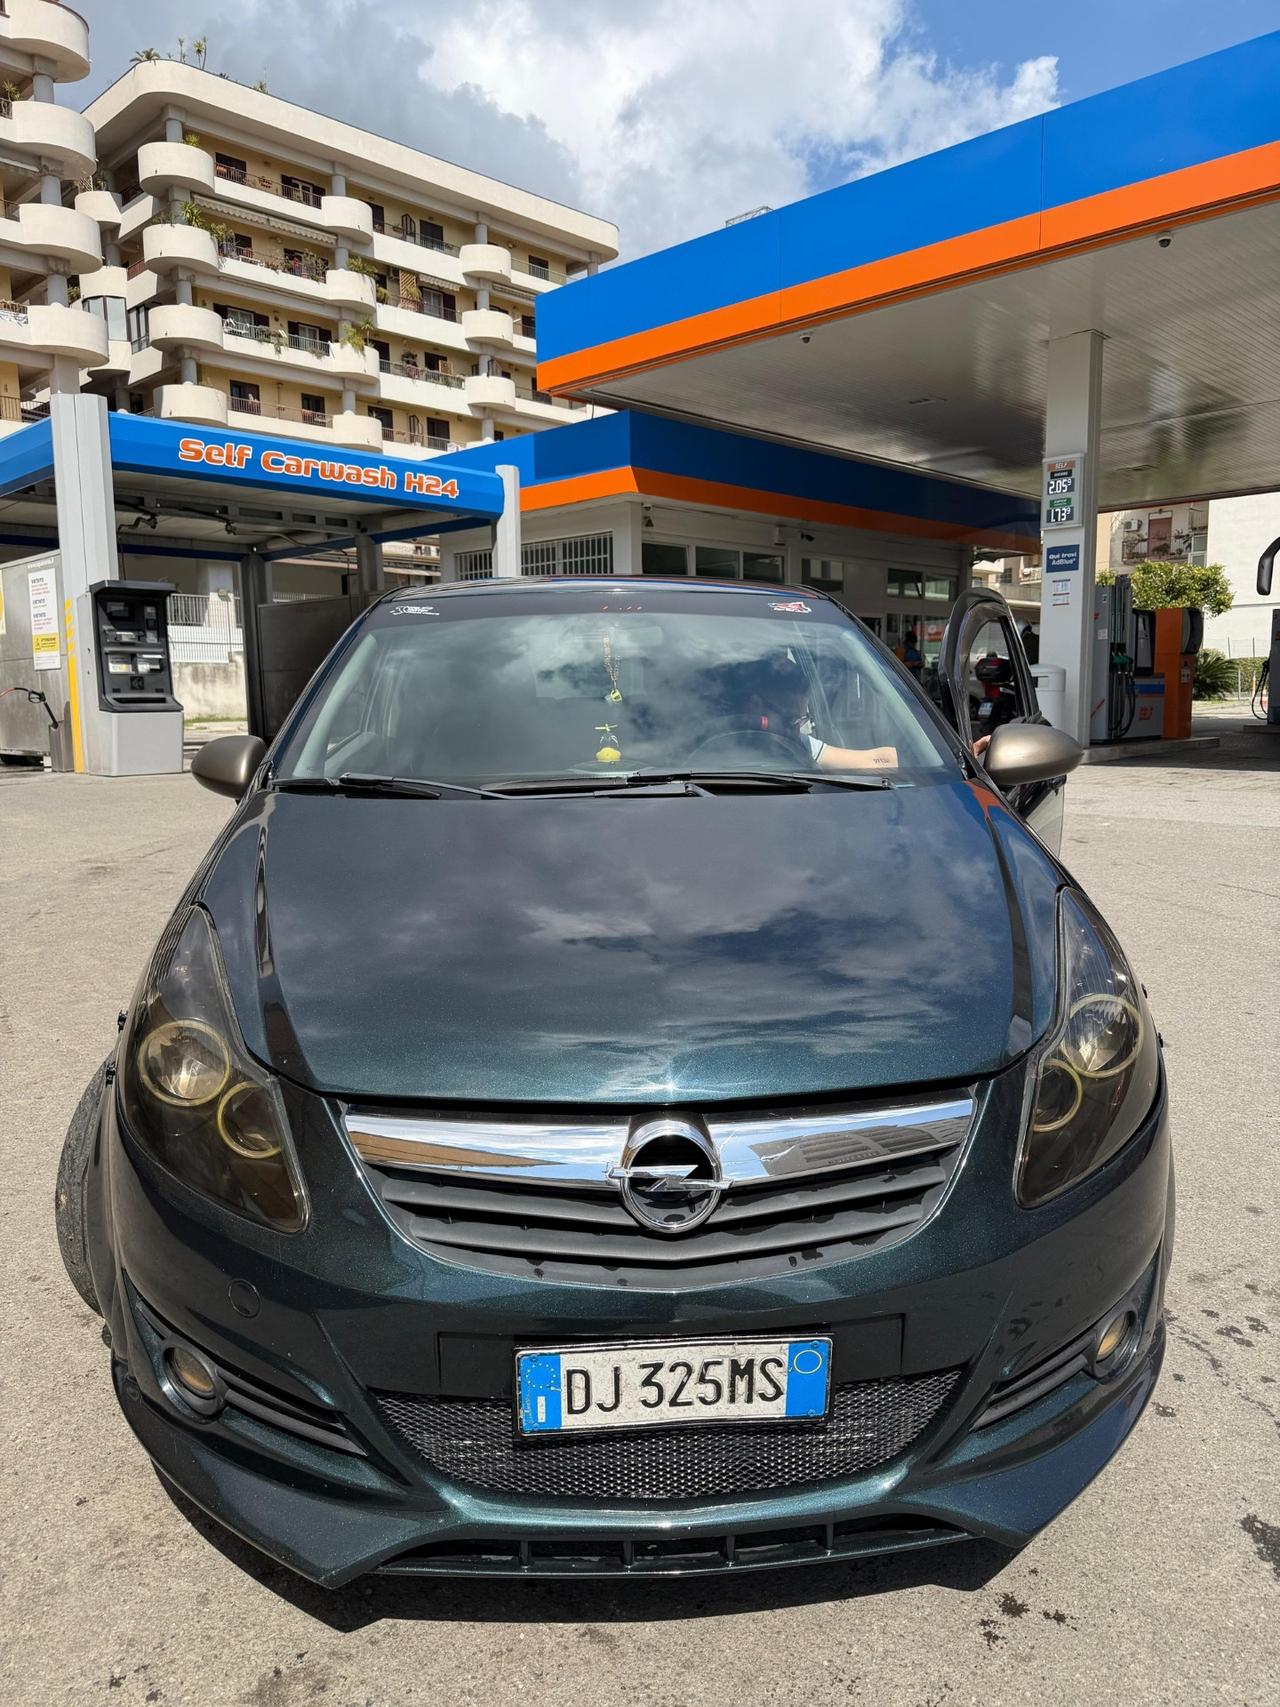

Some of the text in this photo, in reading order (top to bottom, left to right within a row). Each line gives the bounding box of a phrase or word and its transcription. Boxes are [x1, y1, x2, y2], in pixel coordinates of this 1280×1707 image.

[179, 439, 458, 498] Self Carwash H24
[566, 1364, 621, 1416] DJ
